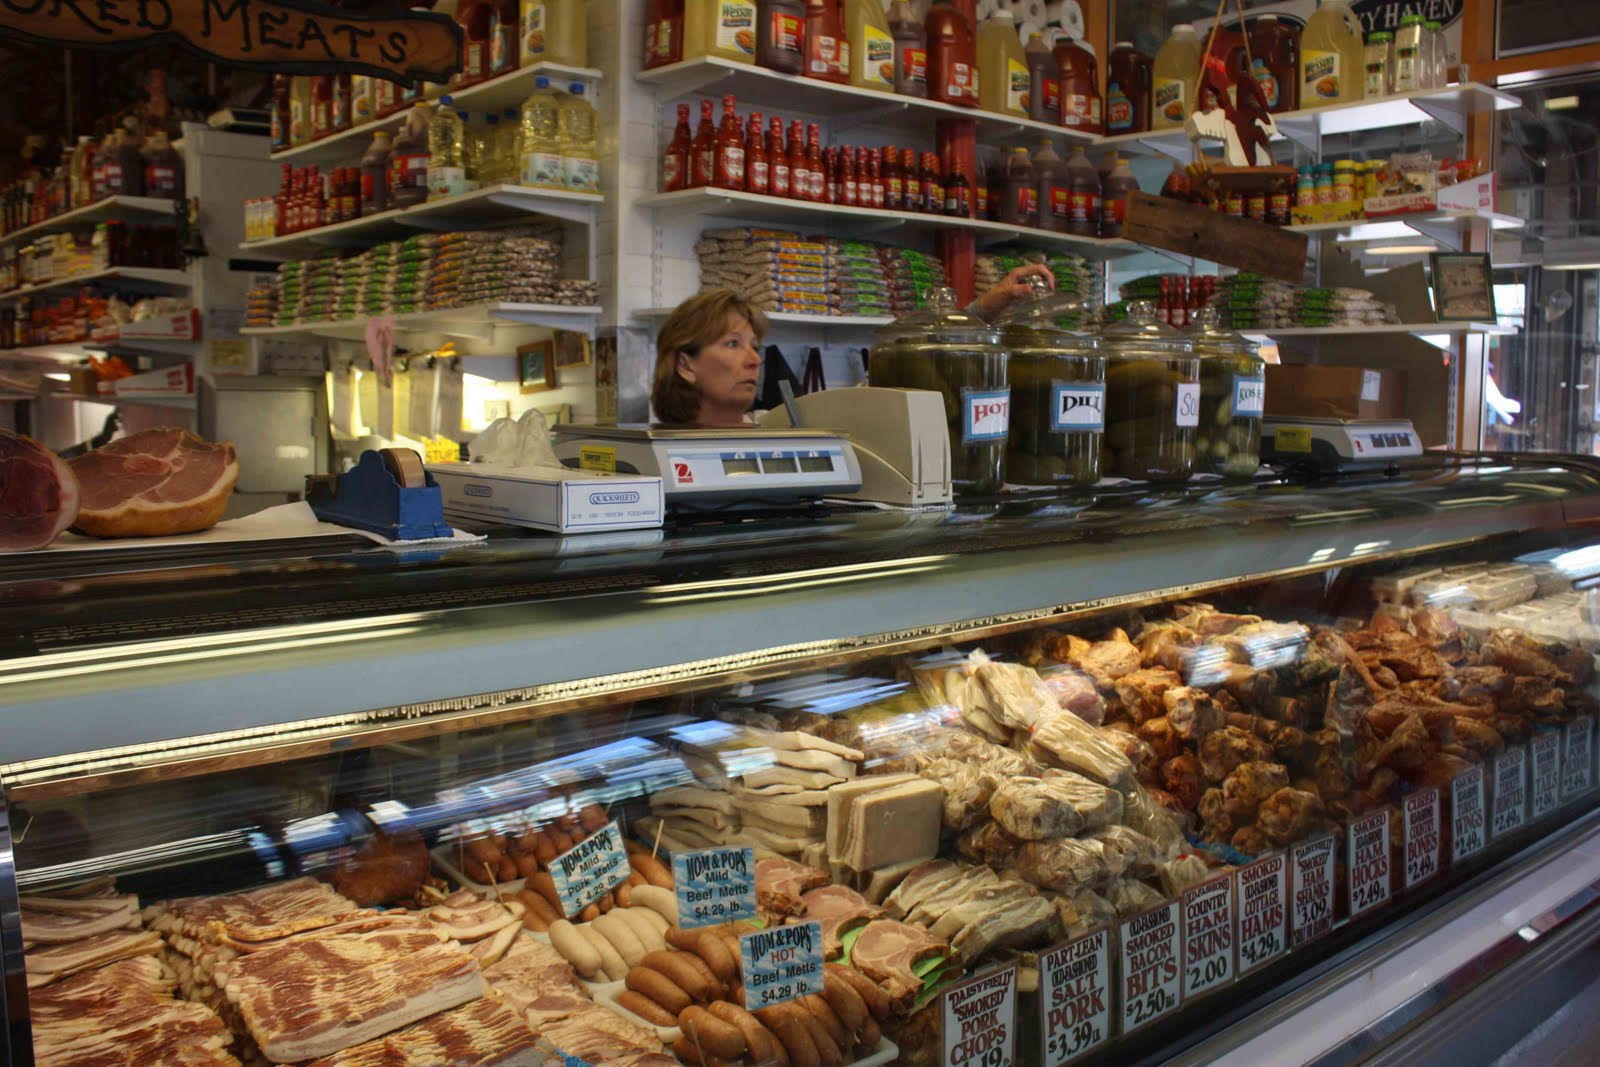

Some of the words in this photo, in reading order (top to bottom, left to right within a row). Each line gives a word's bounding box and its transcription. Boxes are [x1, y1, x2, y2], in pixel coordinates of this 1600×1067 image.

[722, 4, 753, 17] Wesson
[201, 0, 407, 63] MEATS
[974, 402, 1008, 424] HOT
[1062, 396, 1100, 415] DILL
[592, 493, 637, 504] QUICKSHEETS
[1352, 813, 1386, 837] SMOKED
[1455, 809, 1483, 838] WINGS
[581, 845, 589, 858] &
[588, 830, 613, 853] POPS
[1354, 840, 1384, 866] HAM
[1407, 831, 1438, 862] BONES
[568, 877, 590, 897] Pork
[594, 858, 618, 879] Metts
[579, 854, 599, 873] Mild
[686, 855, 710, 886] MOM
[712, 854, 720, 868] &
[721, 850, 747, 877] POPS
[706, 870, 729, 882] Mild
[1242, 858, 1282, 886] SMOKED
[1352, 855, 1388, 889] HOCKS
[1408, 855, 1431, 880] $2.49
[687, 888, 713, 902] Beef
[719, 884, 748, 897] Metts
[1302, 867, 1325, 891] HAM
[1188, 892, 1228, 919] COUNTRY
[1244, 889, 1279, 917] COTTAGE
[1296, 880, 1330, 909] SHANKS
[1353, 880, 1380, 908] $2.49
[695, 904, 724, 918] $4.29
[730, 901, 743, 912] lb.
[1187, 906, 1229, 937] HAM
[1241, 904, 1283, 943] HAMS
[750, 931, 775, 967] MOM
[776, 929, 785, 946] &
[785, 924, 812, 954] POPS
[1047, 933, 1102, 972] PART-LEAN
[1126, 922, 1175, 956] SMOKED
[1187, 924, 1231, 965] SKINS
[1241, 932, 1274, 964] $4.29
[771, 946, 796, 964] HOT
[1130, 940, 1172, 973] BACON
[753, 969, 780, 986] Beef
[786, 962, 816, 979] Metts
[1127, 956, 1178, 1002] BITS
[761, 985, 791, 1003] $4.29
[796, 981, 810, 994] lb.
[1052, 970, 1098, 1008] SALT
[1048, 986, 1105, 1038] PORK
[1126, 988, 1165, 1024] $2.50
[961, 1008, 999, 1040] PORK
[951, 1024, 1006, 1065] CHOPS
[1048, 1021, 1093, 1061] $3.39
